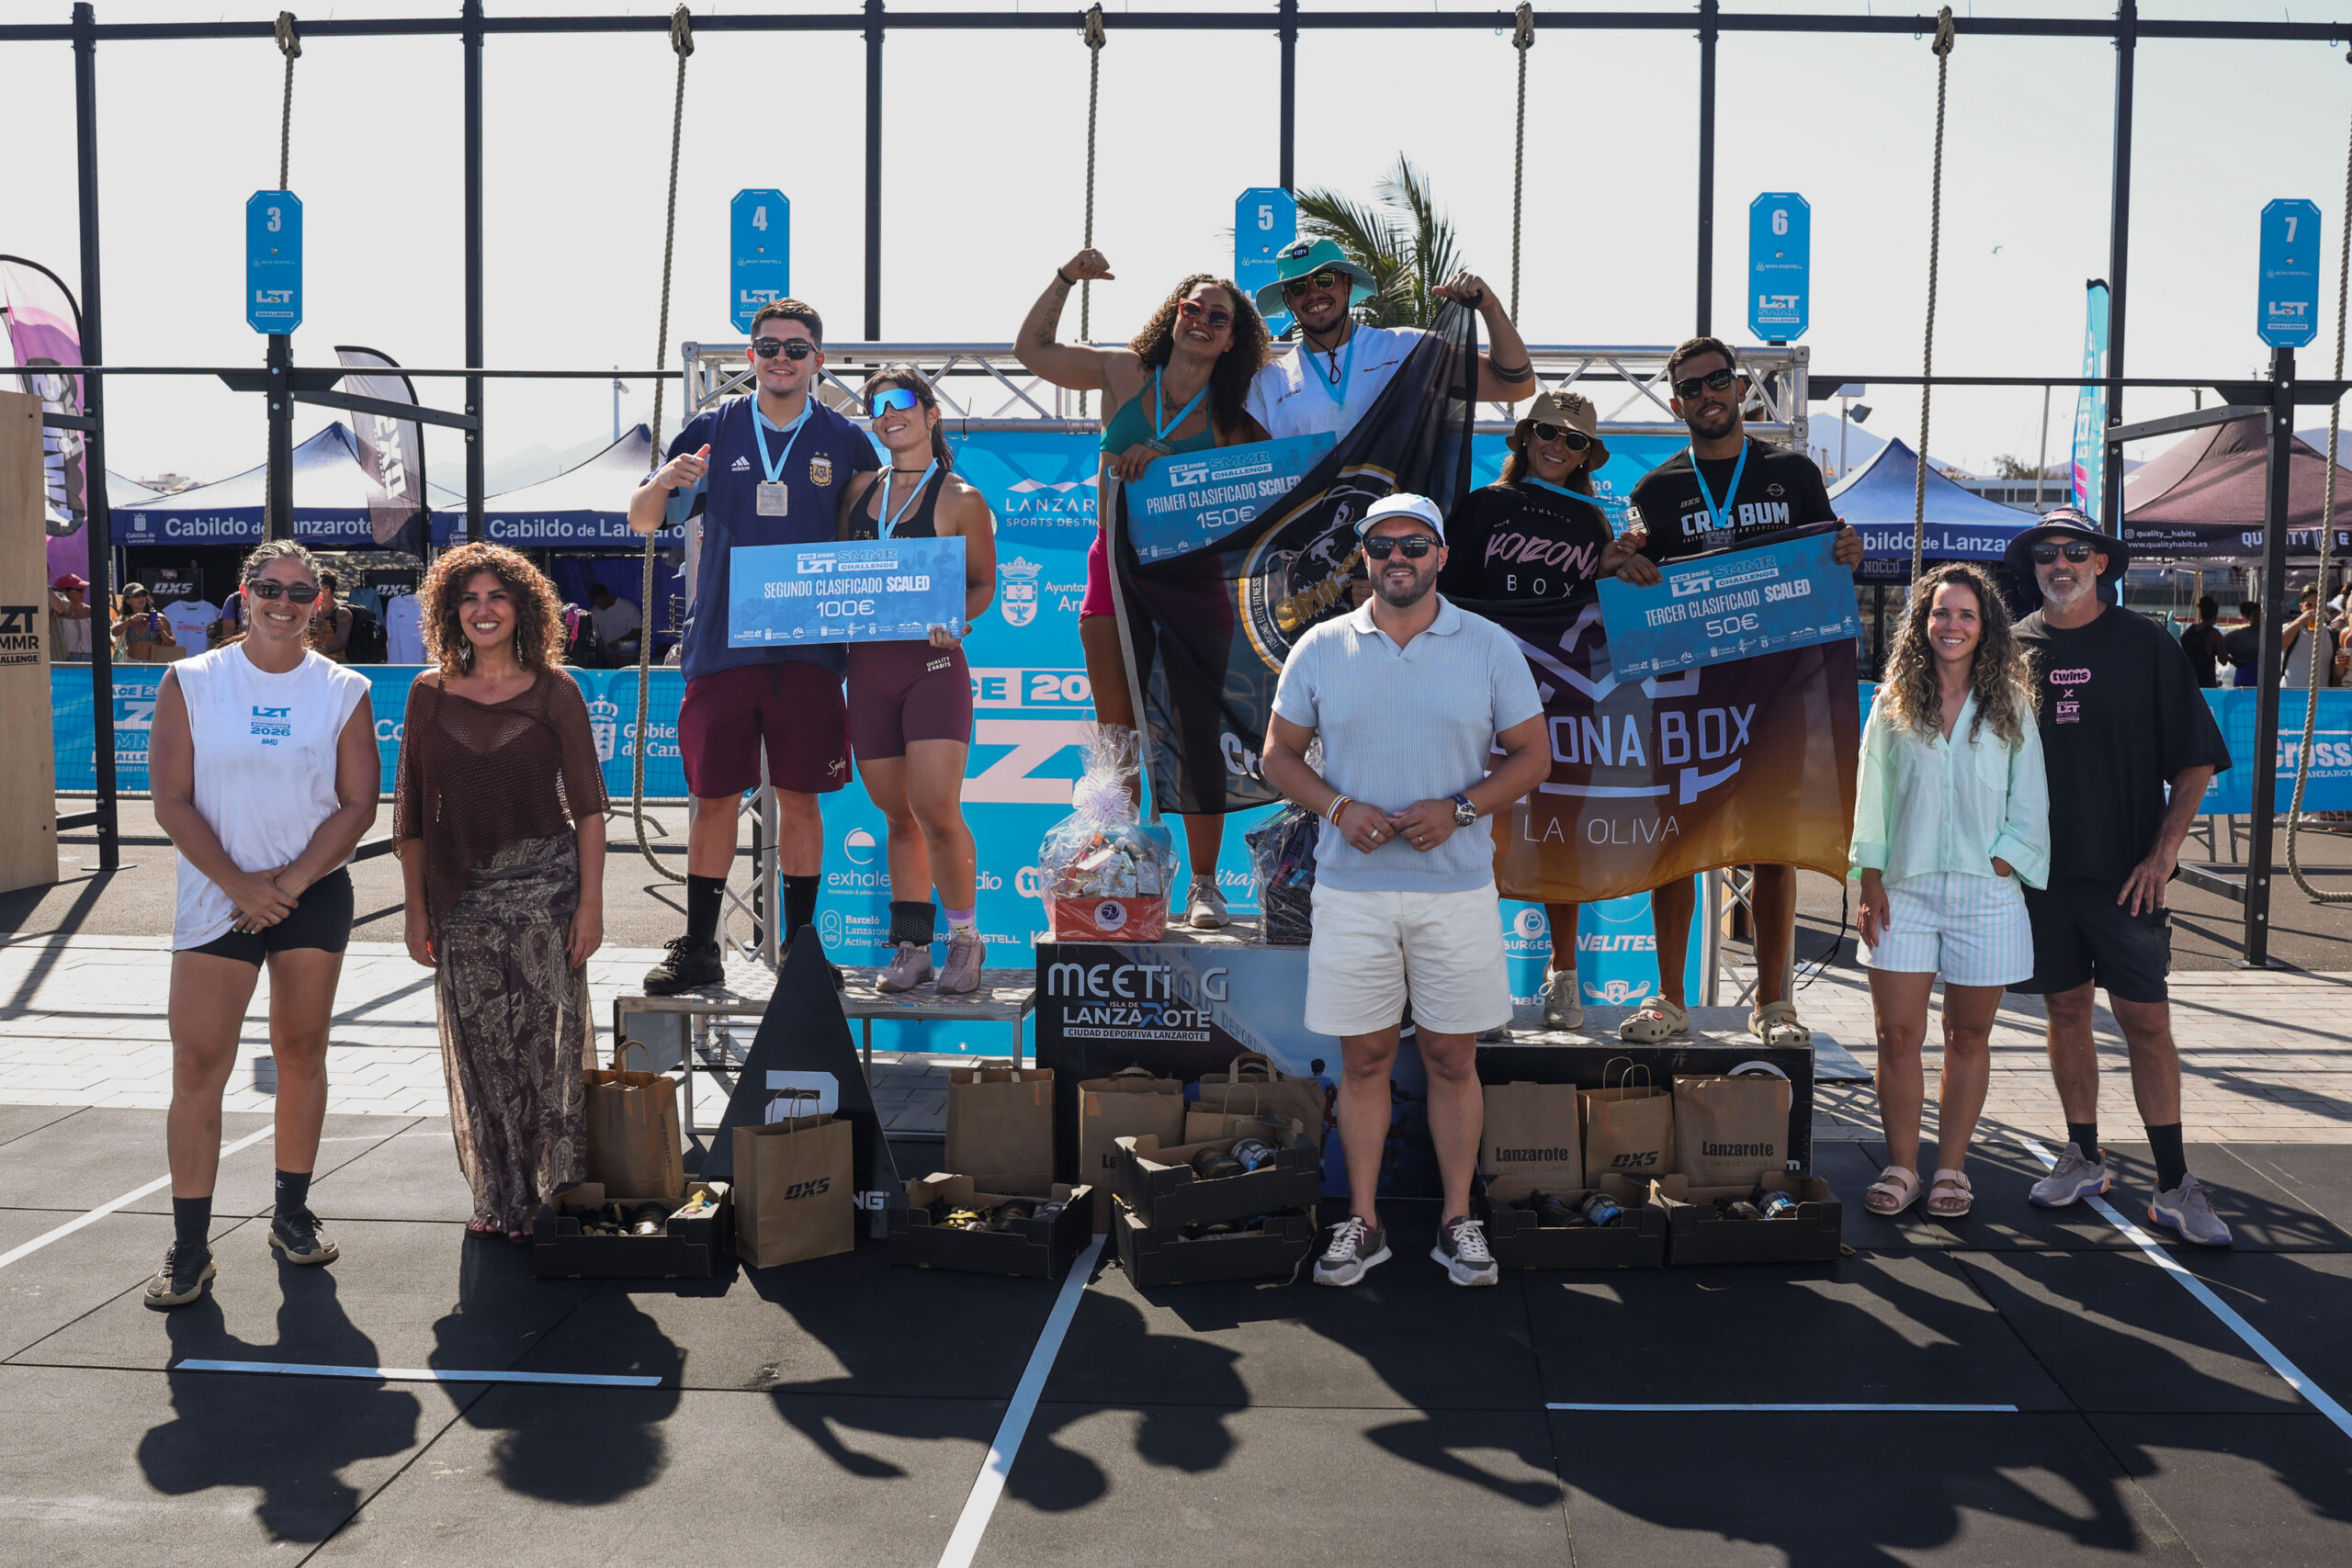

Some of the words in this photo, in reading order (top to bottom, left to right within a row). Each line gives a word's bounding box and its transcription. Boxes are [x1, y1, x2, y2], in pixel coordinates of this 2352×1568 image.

[266, 207, 281, 231] 3
[752, 206, 768, 231] 4
[1258, 205, 1273, 231] 5
[1772, 209, 1788, 235] 6
[2285, 217, 2298, 243] 7
[256, 290, 293, 303] LZT
[741, 289, 779, 302] LZT
[1758, 295, 1800, 309] LZT
[2268, 301, 2309, 315] LZT
[1188, 461, 1207, 469] 2026
[1210, 450, 1270, 470] SMMR
[1170, 468, 1210, 487] LZT
[1213, 464, 1271, 479] CHALLENGE
[1005, 498, 1096, 513] LANZAR
[1147, 493, 1186, 514] PRIMER
[1189, 484, 1257, 508] CLASIFICADO
[165, 517, 248, 536] Cabildo
[252, 521, 265, 536] de
[292, 516, 371, 535] anzarote
[1006, 518, 1053, 527] SPORTS
[1057, 518, 1099, 527] DESTIN
[1196, 505, 1257, 529] 150€
[1680, 508, 1735, 536] CRS
[1738, 502, 1790, 527] BUM
[490, 519, 574, 538] Cabildo
[577, 524, 595, 536] de
[1863, 532, 1915, 550] bildo
[1923, 537, 1939, 549] de
[1943, 532, 2011, 552] Lanza
[2242, 531, 2309, 547] QUITY
[838, 548, 898, 561] SMMR
[797, 559, 837, 574] LZT
[840, 562, 897, 570] CHALLENGE
[1713, 555, 1776, 578] SMMR
[1671, 573, 1690, 582] ACE
[1690, 570, 1710, 579] 2026
[1717, 570, 1777, 588] CHALLENGE
[764, 581, 812, 599] SEGUNDO
[815, 578, 882, 596] CLASIFICADO
[886, 575, 930, 592] SCALED
[1045, 581, 1088, 595] Ayunta
[1252, 577, 1261, 605] FITNESS
[1507, 574, 1575, 598] BOX
[1670, 576, 1713, 597] LZT
[816, 600, 876, 618] 100€
[1645, 604, 1687, 627] TERCER
[1689, 589, 1760, 619] CLASIFICADO
[1765, 578, 1811, 603] SCALED
[0, 606, 38, 634] ZT
[1254, 605, 1267, 624] ELITE
[1705, 613, 1760, 637] 50€
[0, 636, 39, 650] MMR
[1260, 624, 1279, 649] FORGING
[0, 655, 38, 664] ALLENGE
[926, 656, 950, 667] QUALITY
[932, 661, 951, 671] HABITS
[2052, 671, 2089, 682] twins
[1031, 674, 1092, 702] 20
[253, 705, 290, 717] LZT
[2057, 705, 2080, 714] LZT
[251, 728, 290, 737] 2026
[1549, 714, 1646, 766] ONA
[1660, 705, 1757, 765] BOX
[646, 741, 682, 758] Can
[1523, 814, 1565, 844] LA
[1588, 815, 1679, 845] OLIVA
[828, 869, 891, 887] exhale
[976, 871, 1001, 890] dio
[845, 915, 880, 925] Barceló
[845, 926, 890, 936] Lanzarote
[845, 937, 872, 947] Active
[1503, 940, 1553, 950] BURGER
[1577, 932, 1657, 952] VELITES
[1063, 1002, 1211, 1028] LANZAROTE
[1069, 1029, 1101, 1037] CIUDAD
[1103, 1030, 1152, 1039] DEPORTIVA
[1154, 1031, 1205, 1040] LANZAROTE
[1496, 1146, 1568, 1162] Lanzarote
[1702, 1141, 1774, 1157] Lanzarote
